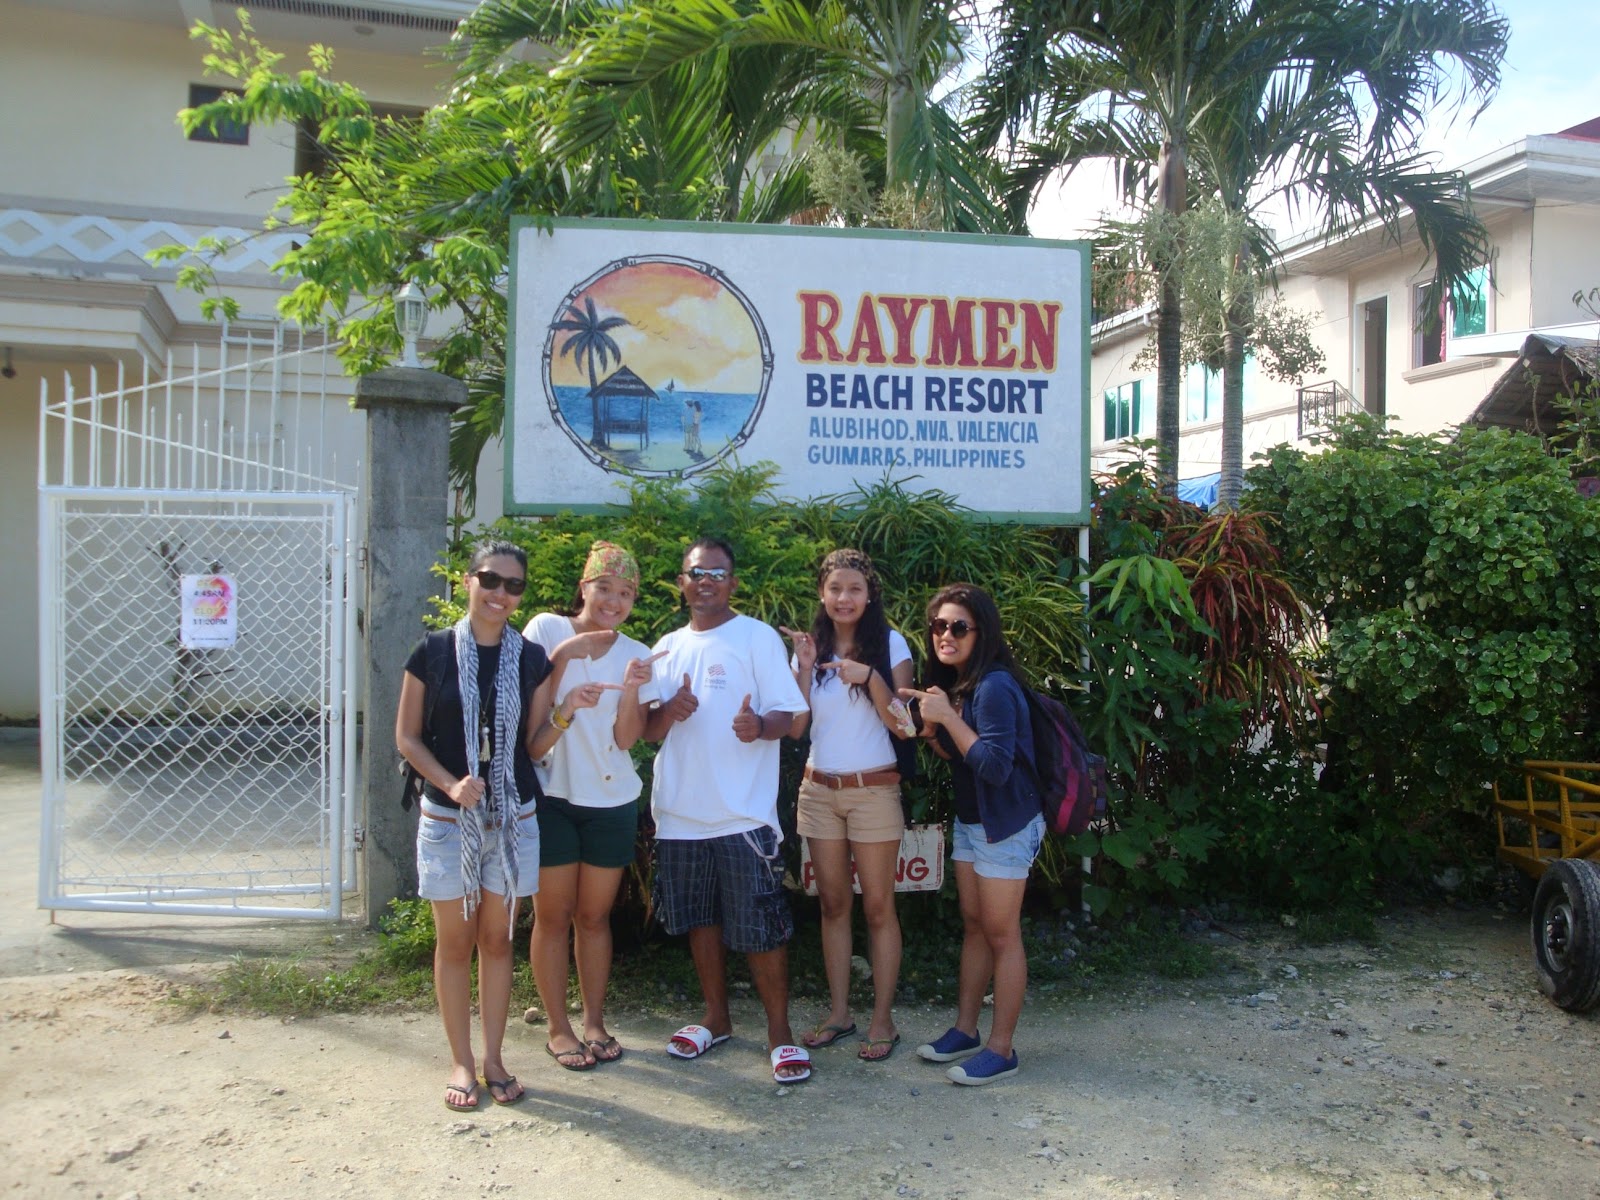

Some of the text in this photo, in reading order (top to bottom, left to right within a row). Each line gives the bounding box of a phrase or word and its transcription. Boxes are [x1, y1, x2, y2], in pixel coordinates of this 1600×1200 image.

[798, 291, 1062, 372] RAYMEN
[806, 373, 1049, 414] BEACH RESORT
[957, 420, 1039, 443] VALENCIA
